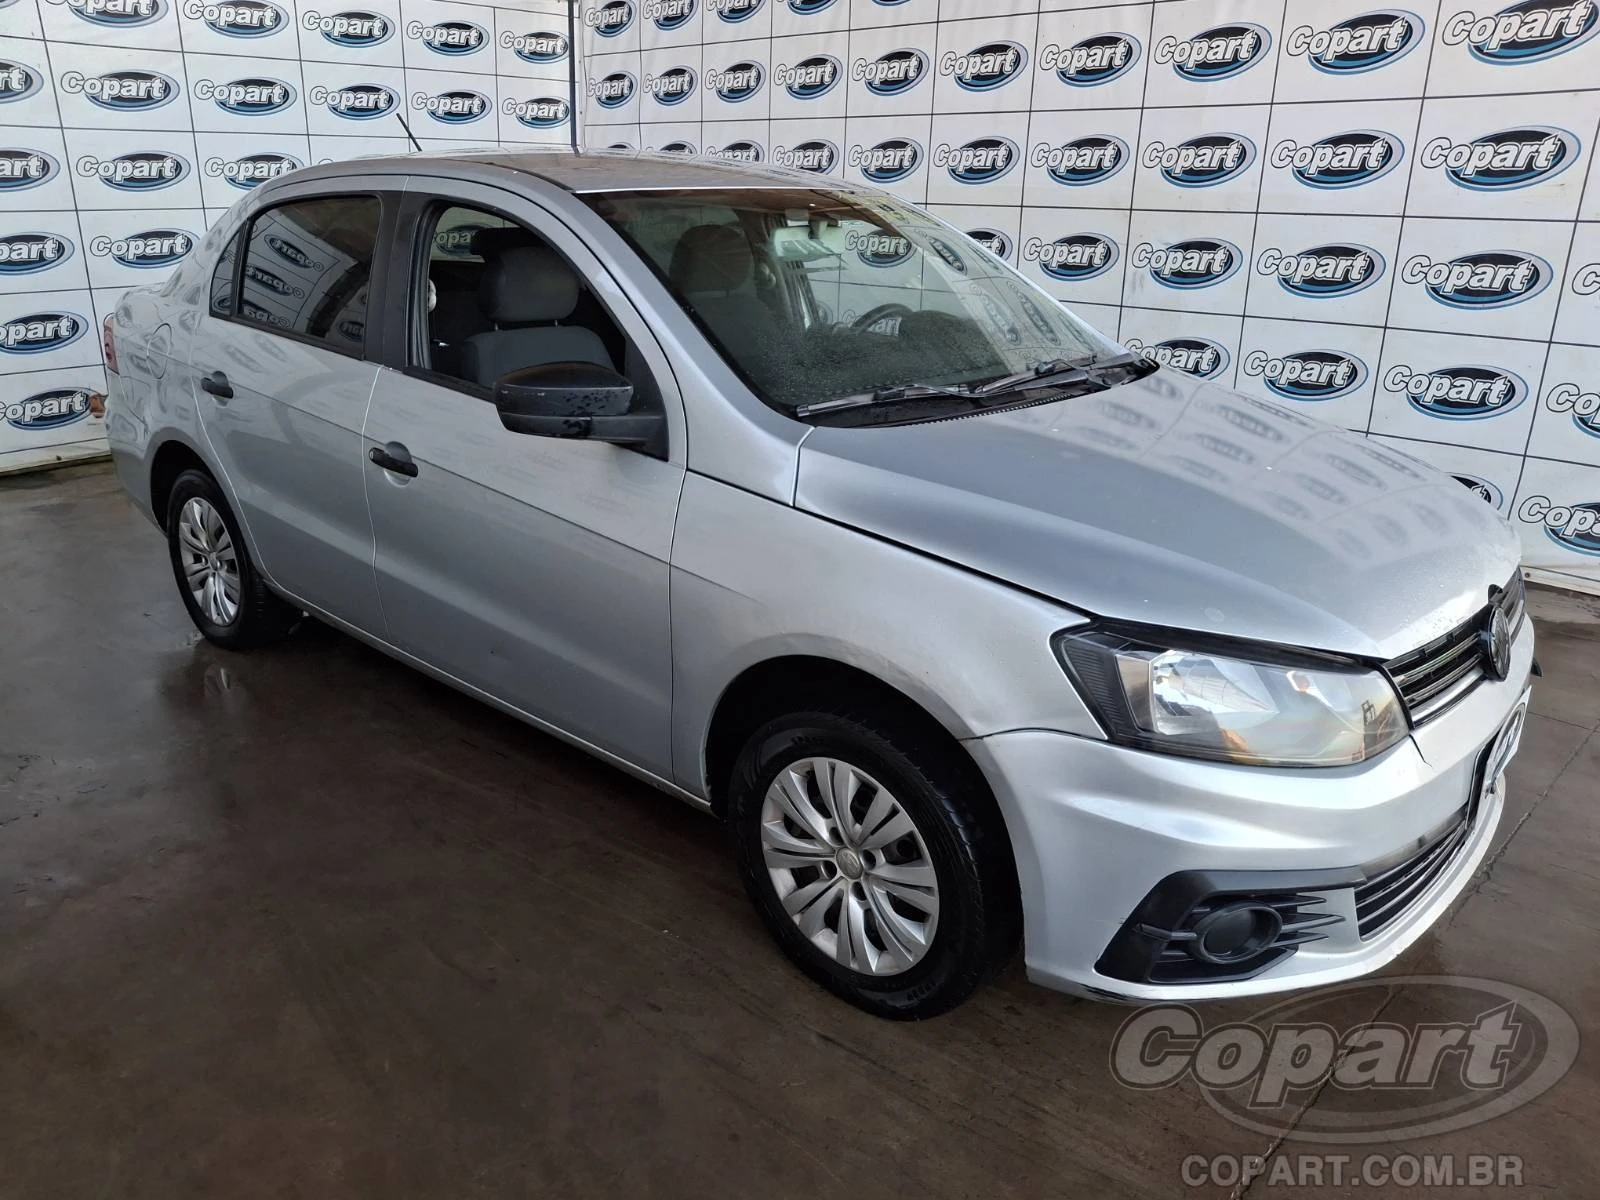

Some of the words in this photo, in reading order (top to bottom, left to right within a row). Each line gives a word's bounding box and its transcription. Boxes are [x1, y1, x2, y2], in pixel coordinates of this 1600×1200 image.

[184, 0, 277, 27] Copart
[302, 11, 384, 37] Copart
[584, 4, 630, 30] Copart
[1442, 0, 1592, 52] Copart
[407, 21, 480, 46] Copart
[500, 31, 565, 54] Copart
[1286, 17, 1408, 62] Copart
[940, 46, 1017, 80] Copart
[1040, 38, 1129, 76] Copart
[1154, 29, 1257, 70] Copart
[643, 71, 691, 98] Copart
[705, 67, 759, 93] Copart
[774, 59, 834, 91] Copart
[852, 53, 920, 86] Copart
[61, 71, 165, 100] Copart
[194, 79, 285, 105] Copart
[310, 86, 390, 112] Copart
[586, 76, 631, 100] Copart
[411, 92, 483, 115] Copart
[502, 98, 566, 120] Copart
[0, 155, 43, 178] art
[76, 156, 177, 183] Copart
[205, 157, 293, 181] Copart
[773, 145, 830, 170] Copart
[848, 143, 918, 174] Copart
[933, 142, 1010, 173] Copart
[1031, 140, 1117, 175] Copart
[1142, 139, 1241, 176] Copart
[1271, 137, 1389, 176] Copart
[1421, 133, 1561, 177] Copart
[90, 235, 187, 260] Copart
[845, 229, 909, 258] Copart
[1023, 237, 1109, 269] Copart
[1132, 243, 1228, 277] Copart
[1257, 248, 1369, 285] Copart
[1402, 255, 1534, 294] Copart
[0, 315, 73, 347] part
[1244, 350, 1352, 386] Copart
[1384, 365, 1511, 405] Copart
[0, 390, 85, 424] opart
